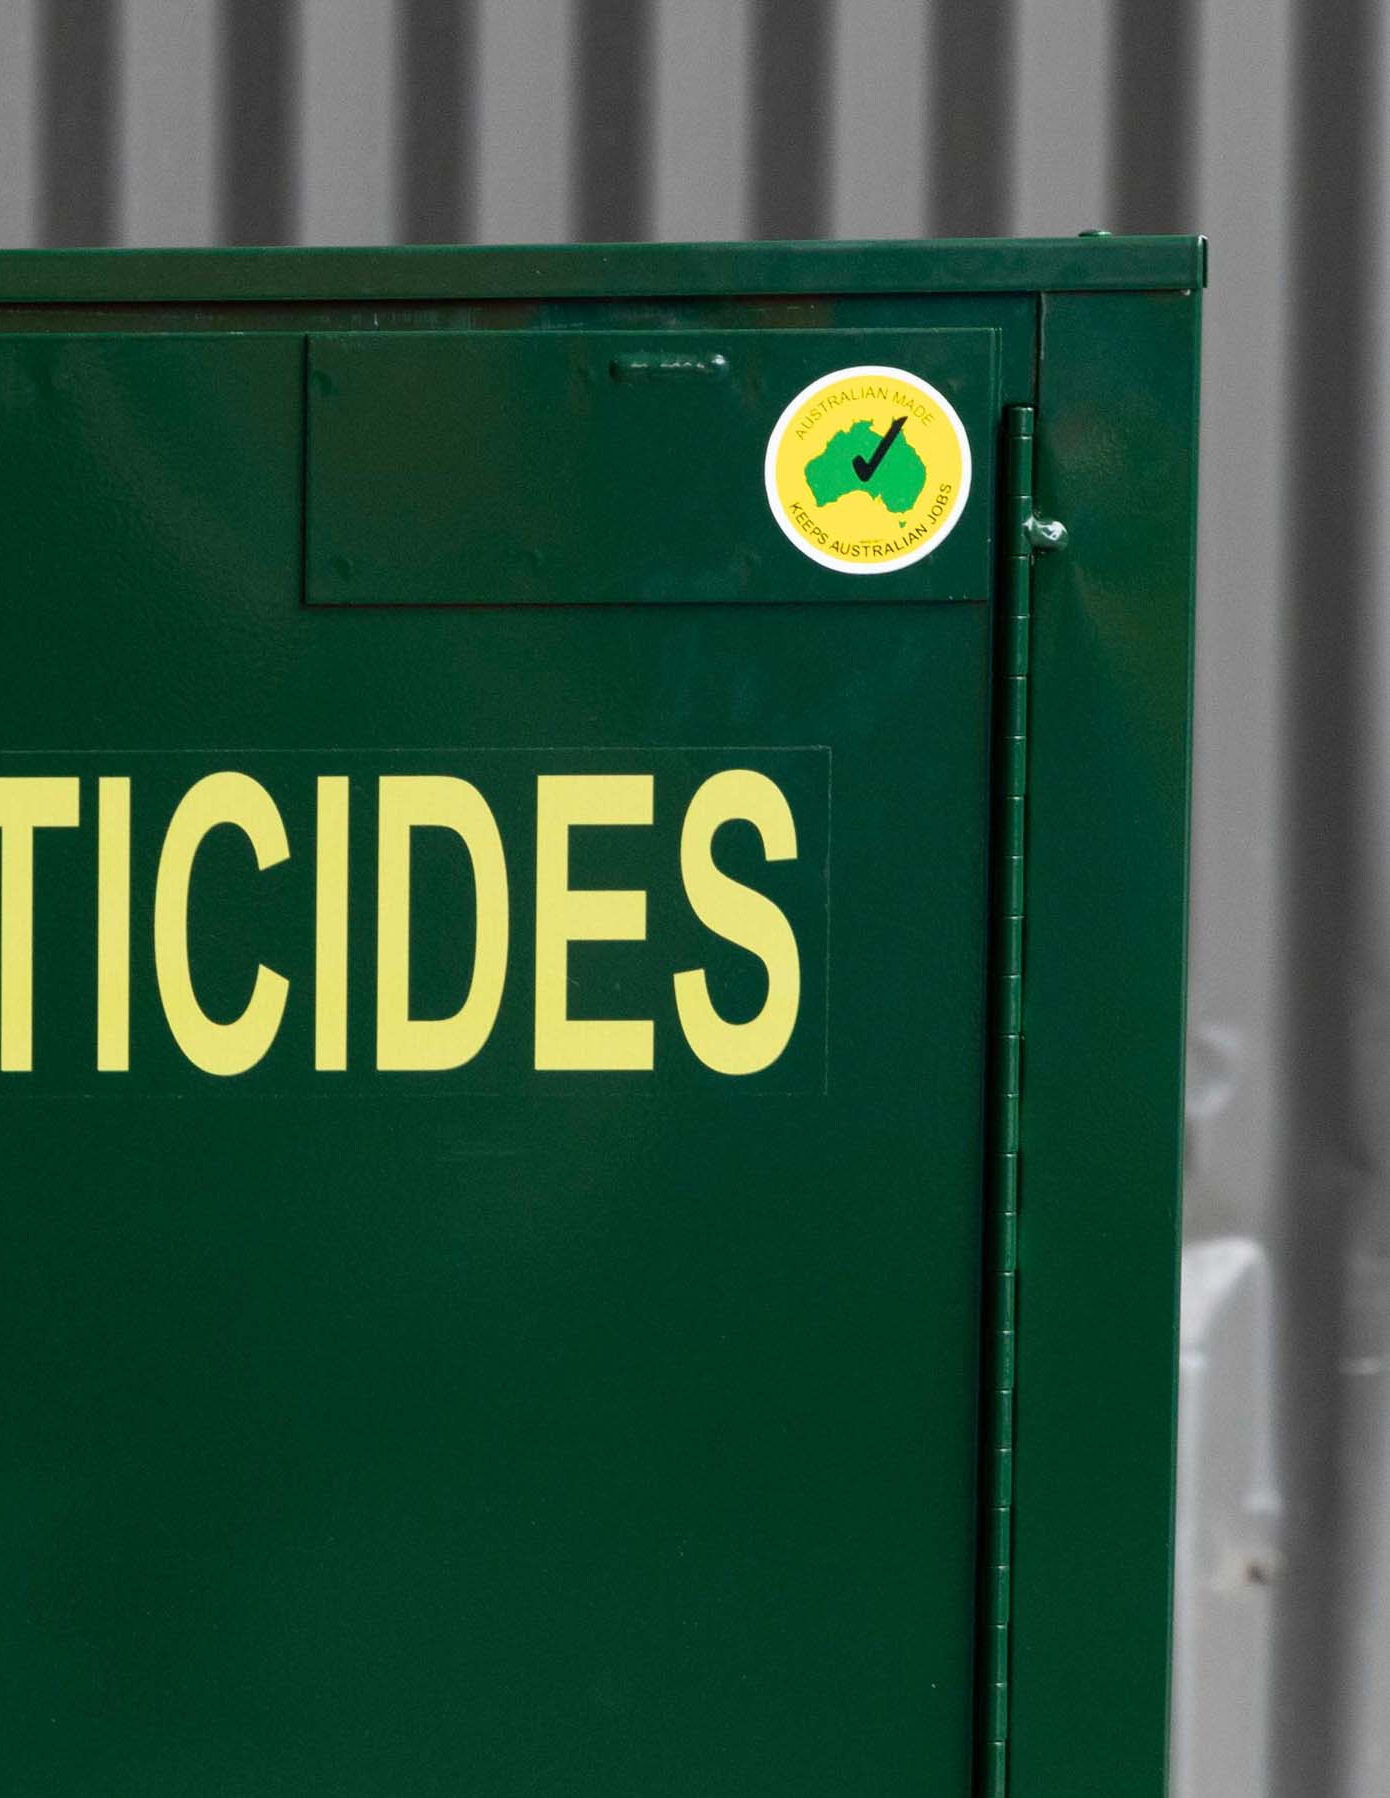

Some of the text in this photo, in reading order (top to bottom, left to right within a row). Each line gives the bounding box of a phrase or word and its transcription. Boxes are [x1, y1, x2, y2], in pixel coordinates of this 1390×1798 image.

[795, 386, 935, 440] AUSTRALIAN MADE
[790, 483, 952, 558] KEEPS AUSTRALIAN JOBS
